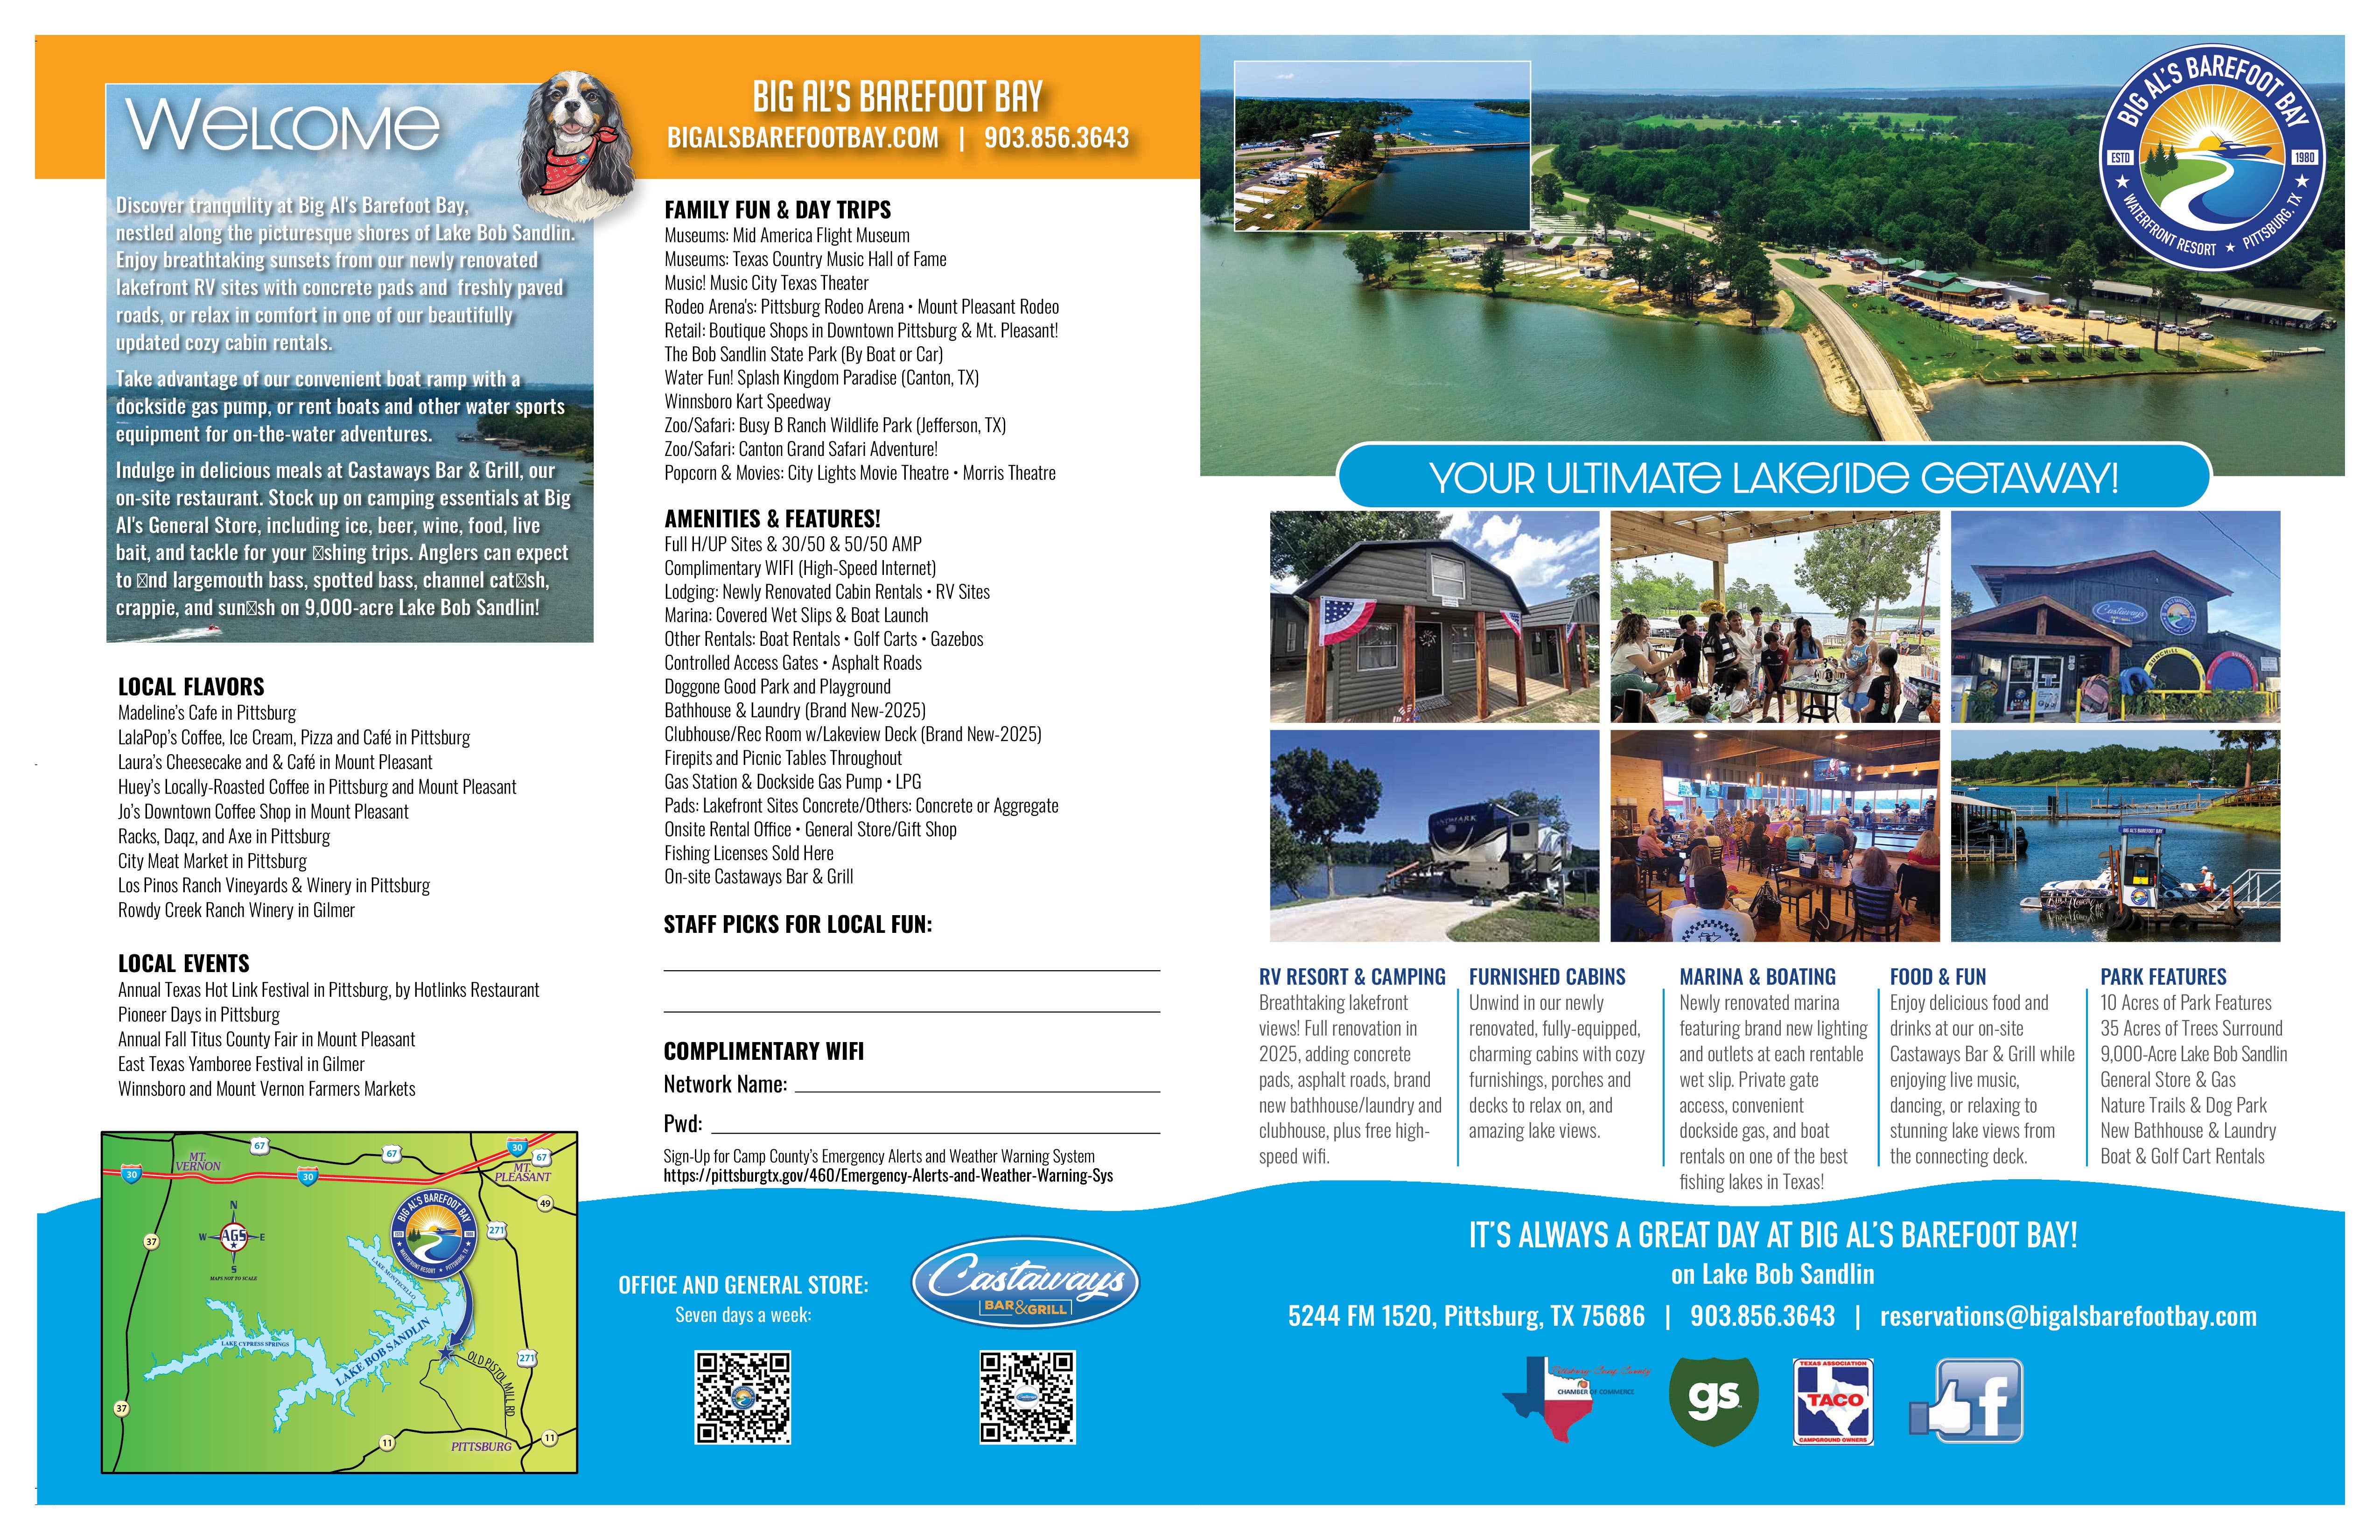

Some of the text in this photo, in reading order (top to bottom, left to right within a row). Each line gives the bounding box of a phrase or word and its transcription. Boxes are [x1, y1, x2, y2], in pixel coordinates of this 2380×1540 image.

[755, 80, 1042, 112] BIG AL'S BAREFOOT BAY
[2117, 92, 2149, 127] BIG
[2186, 55, 2285, 98] BAREFOOT
[2275, 91, 2310, 127] BAY
[669, 127, 938, 147] BIGALSBAREFOOTBAY.COM
[986, 127, 1128, 147] 903.856.3643
[2112, 152, 2130, 163] ESTD
[2296, 152, 2315, 163] 1980
[117, 196, 468, 217] Discover tranquility at Big Al's Barefoot Bay,
[2287, 192, 2303, 206] TX
[666, 200, 891, 219] FAMILY FUN & DAY TRIPS
[2123, 193, 2217, 256] WATERFRONT RESORT
[117, 334, 332, 354] updated cozy cabin rentals.
[665, 393, 830, 412] Winnsboro Kart Speedway
[1430, 462, 1534, 493] YOUR
[119, 677, 264, 696] LOCAL FLAVORS
[666, 702, 925, 721] Bathhouse & Laundry (Brand New-2025)
[119, 828, 330, 847] Racks, Daqz, and Axe in Pittsburg
[1260, 968, 1445, 985] RV RESORT & CAMPING
[1891, 968, 1985, 985] FOOD & FUN
[2102, 968, 2226, 985] PARK FEATURES
[1470, 1020, 1640, 1039] renovated, fully-equipped,
[665, 1042, 863, 1060] COMPLIMENTARY WIFI
[2101, 1045, 2287, 1063] 9,000-Acre Lake Bob Sandlin
[665, 1075, 786, 1092] Network Name:
[1680, 1071, 1818, 1091] wet slip. Private gate
[665, 1114, 702, 1133] Pwd:
[175, 1162, 221, 1170] VERNON
[189, 1152, 206, 1162] MT.
[513, 1163, 531, 1172] MT.
[665, 1168, 1113, 1185] https://pittsburgtx.gov/460/Emergency-Alerts-and-Weather-Warning-Sys
[495, 1173, 552, 1182] PLEASANT
[230, 1200, 238, 1209] N
[397, 1208, 410, 1222] BIG
[423, 1193, 462, 1211] BAREFOOT
[458, 1208, 471, 1223] BAY
[221, 1229, 246, 1241] AGS
[399, 1248, 420, 1270] WATERFRONT
[371, 1257, 416, 1300] LAKE MONTECELLO
[929, 1253, 1125, 1302] Castaways
[1673, 1263, 1874, 1284] on Lake Bob Sandlin
[620, 1276, 868, 1294] OFFICE AND GENERAL STORE:
[1289, 1305, 1644, 1330] 5244 FM 1520, Pittsburg, TX 75686
[1692, 1305, 1834, 1326] 903.856.3643
[1882, 1305, 2256, 1330] reservations@bigalsbarefootbay.com
[335, 1316, 431, 1386] LAKE BOB SANDLIN
[1620, 1365, 1652, 1378] County
[468, 1351, 515, 1416] OLD PISTOL MILL RD
[1688, 1382, 1740, 1421] gs
[1807, 1393, 1864, 1407] TACO
[451, 1442, 512, 1451] PITTSBURG
